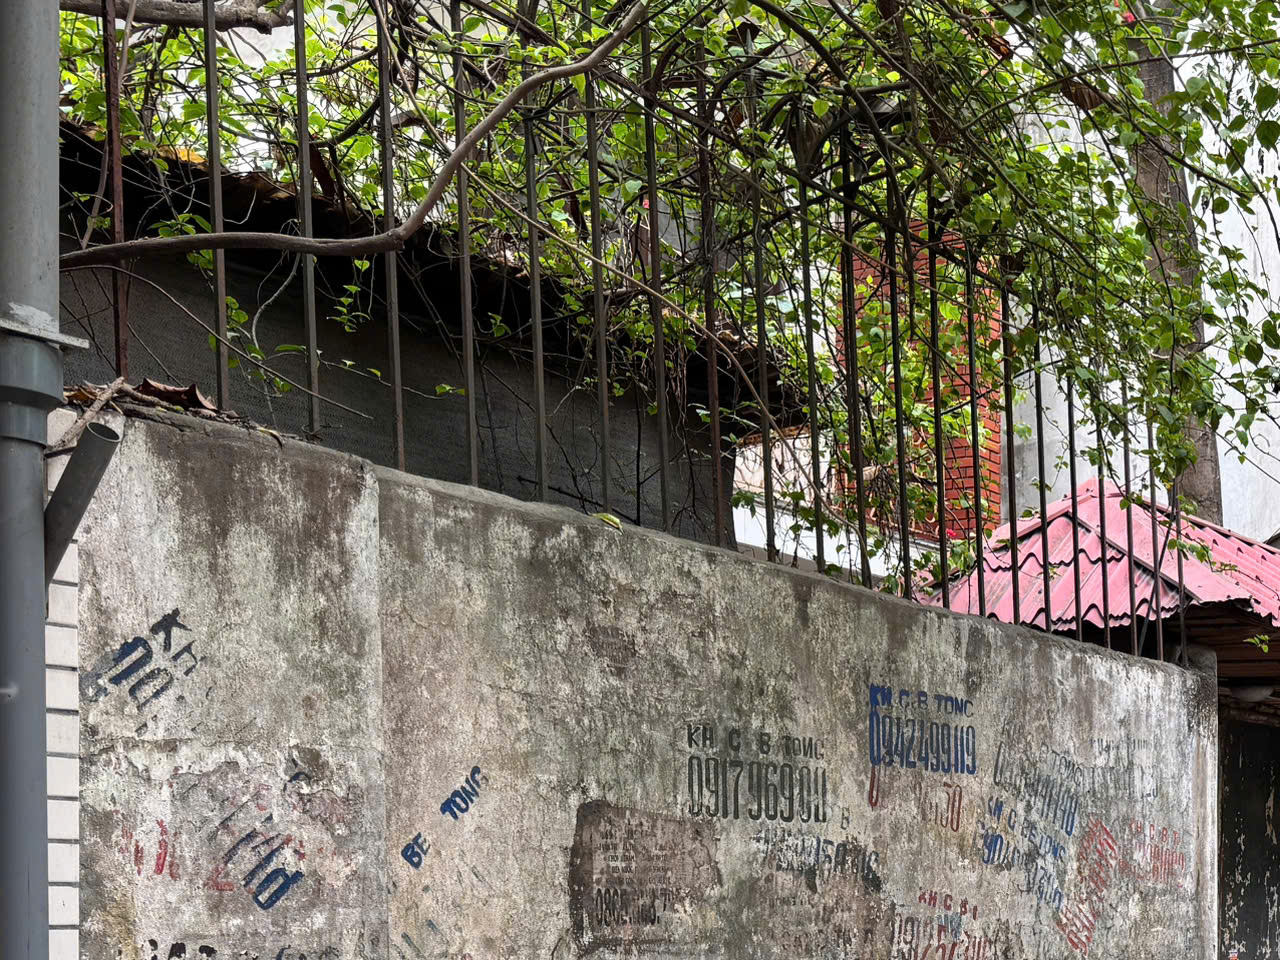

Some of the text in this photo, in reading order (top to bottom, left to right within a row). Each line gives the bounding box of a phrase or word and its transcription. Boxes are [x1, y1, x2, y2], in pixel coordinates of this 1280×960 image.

[687, 724, 713, 748] KH
[728, 729, 741, 751] C
[760, 732, 770, 755] B
[401, 832, 430, 871] BE
